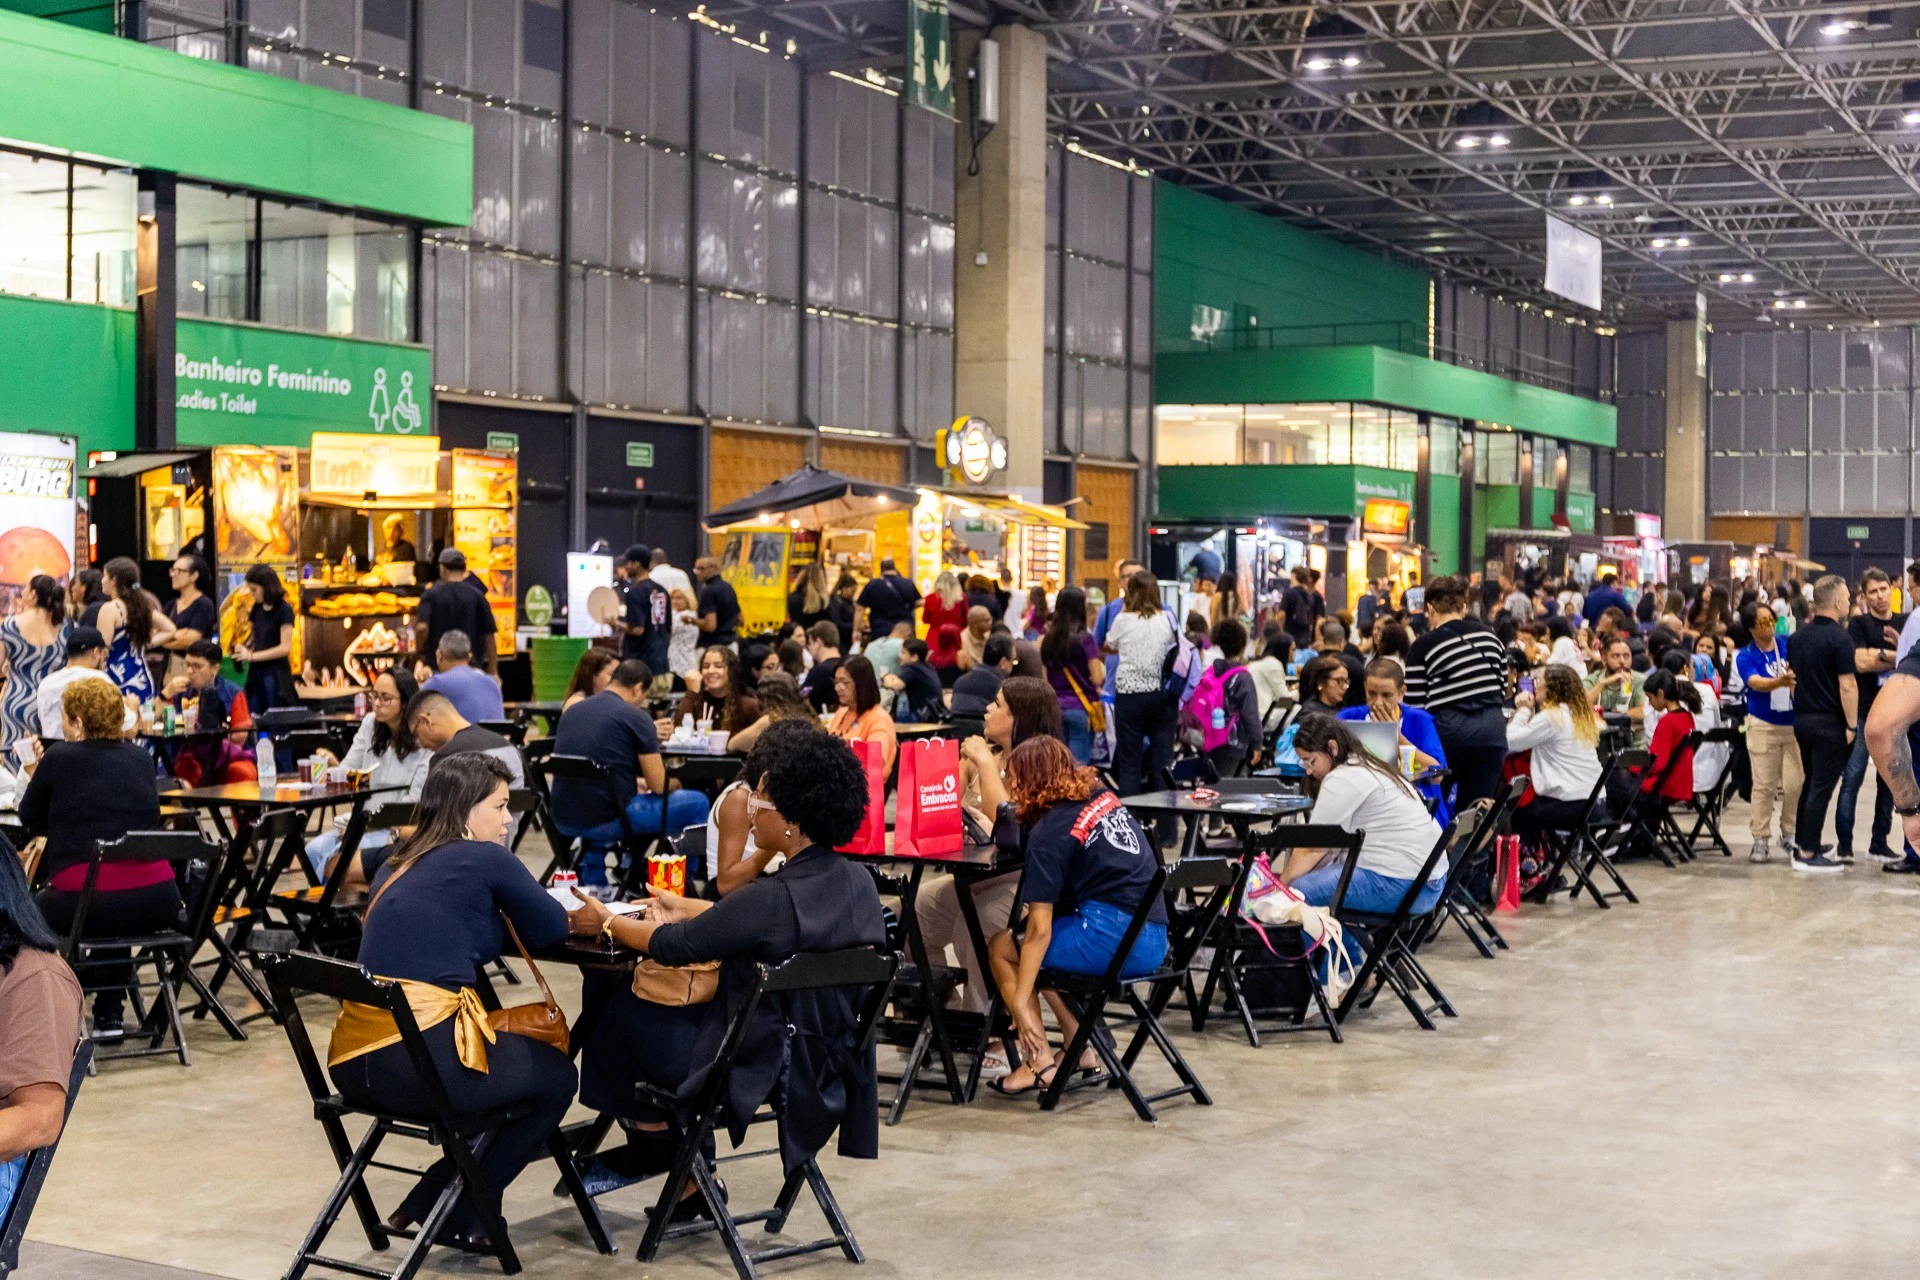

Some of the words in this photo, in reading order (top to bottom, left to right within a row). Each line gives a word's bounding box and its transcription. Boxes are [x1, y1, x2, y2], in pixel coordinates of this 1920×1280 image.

[175, 352, 262, 386] Banheiro
[268, 363, 351, 395] Feminino
[176, 389, 217, 411] adies
[220, 393, 257, 415] Toilet
[920, 791, 958, 807] Embracon
